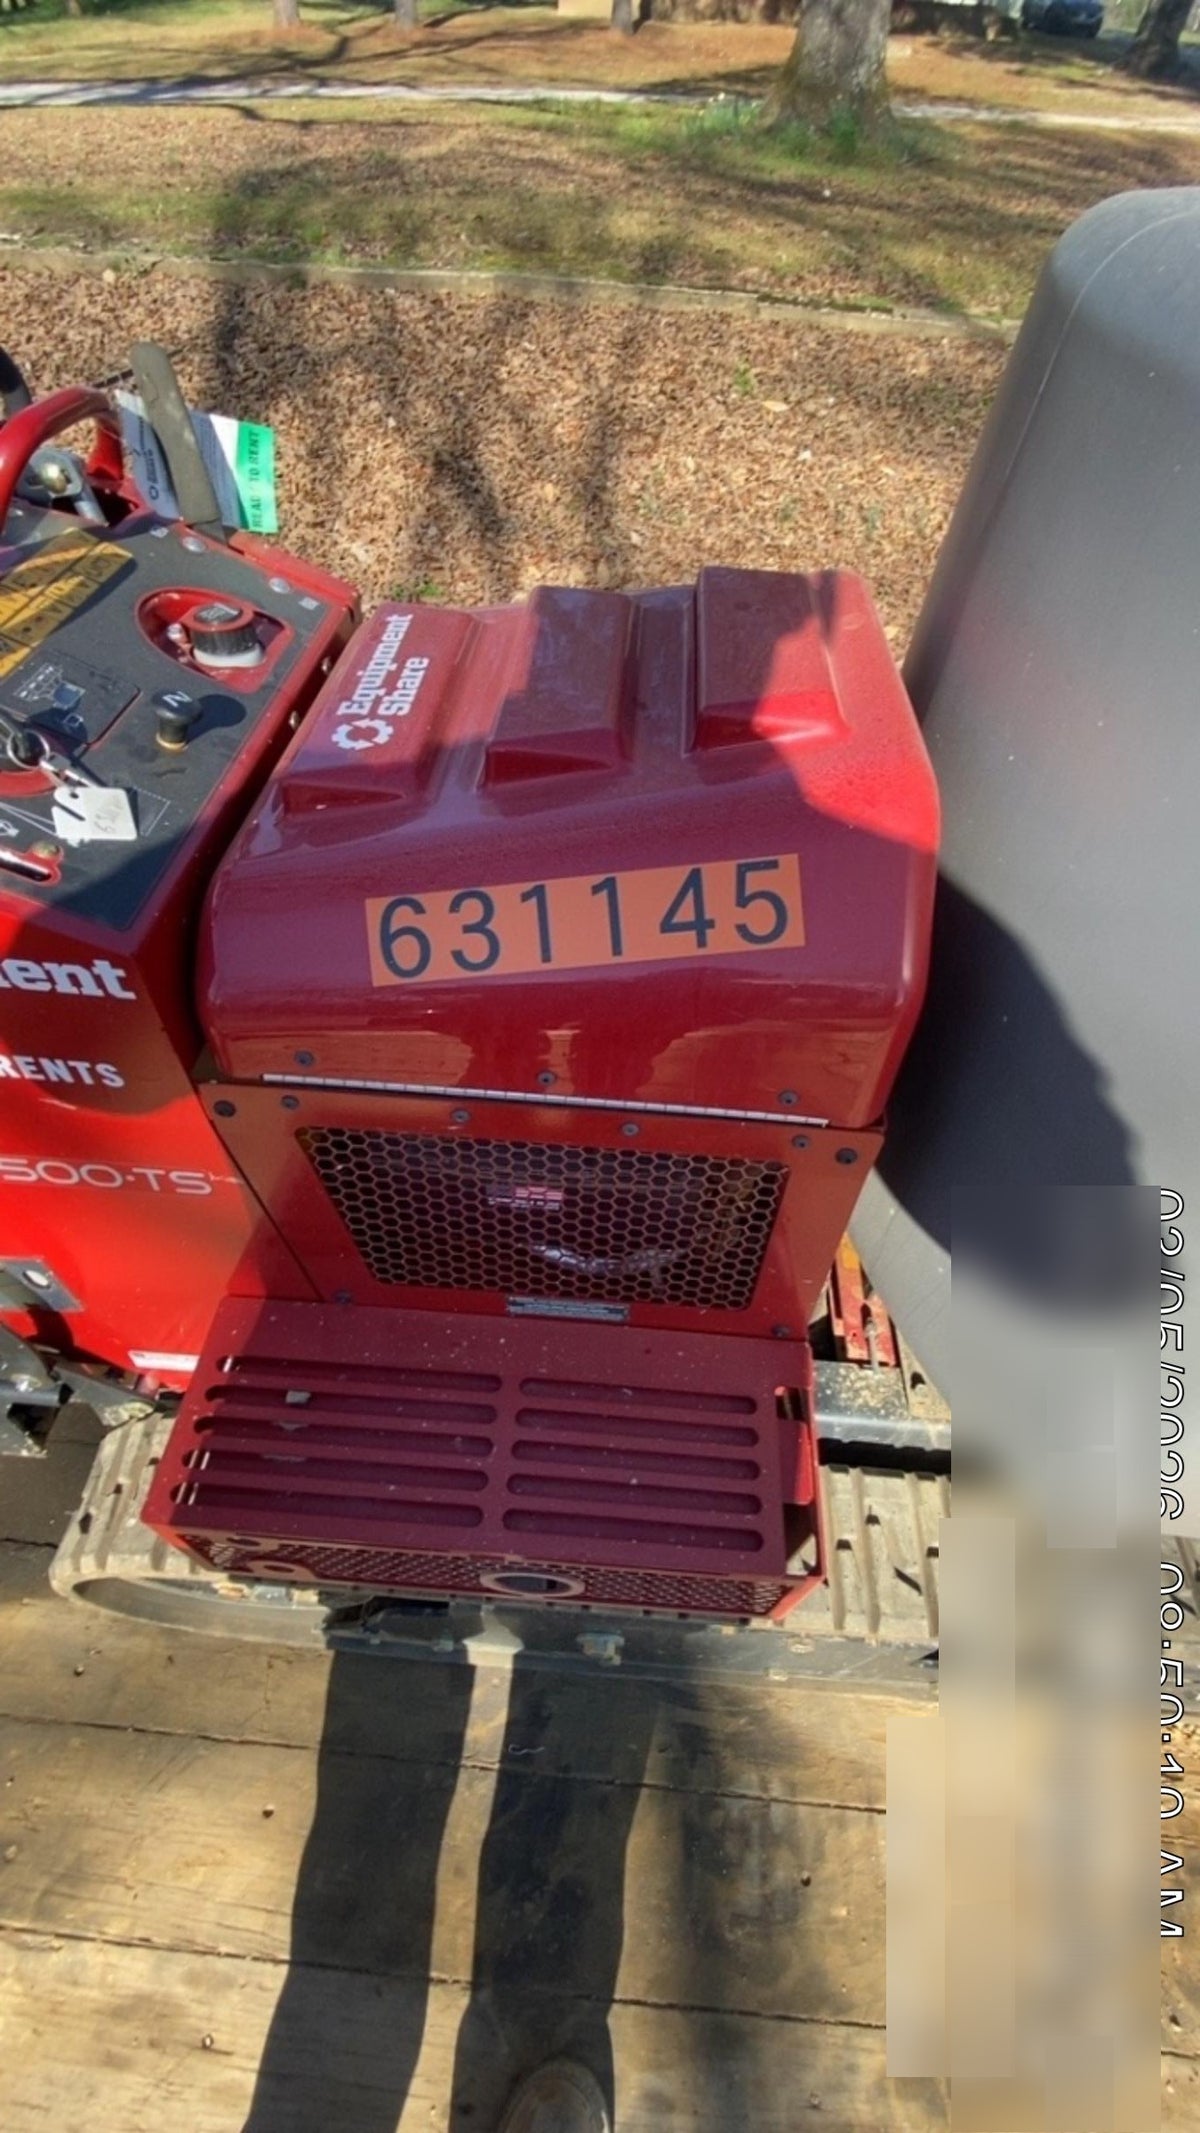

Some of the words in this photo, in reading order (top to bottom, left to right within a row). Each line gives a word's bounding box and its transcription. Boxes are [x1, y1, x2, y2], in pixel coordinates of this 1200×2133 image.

[335, 614, 414, 716] Equipment
[377, 657, 430, 716] Share
[380, 859, 788, 979] 631145
[0, 958, 137, 1000] ent
